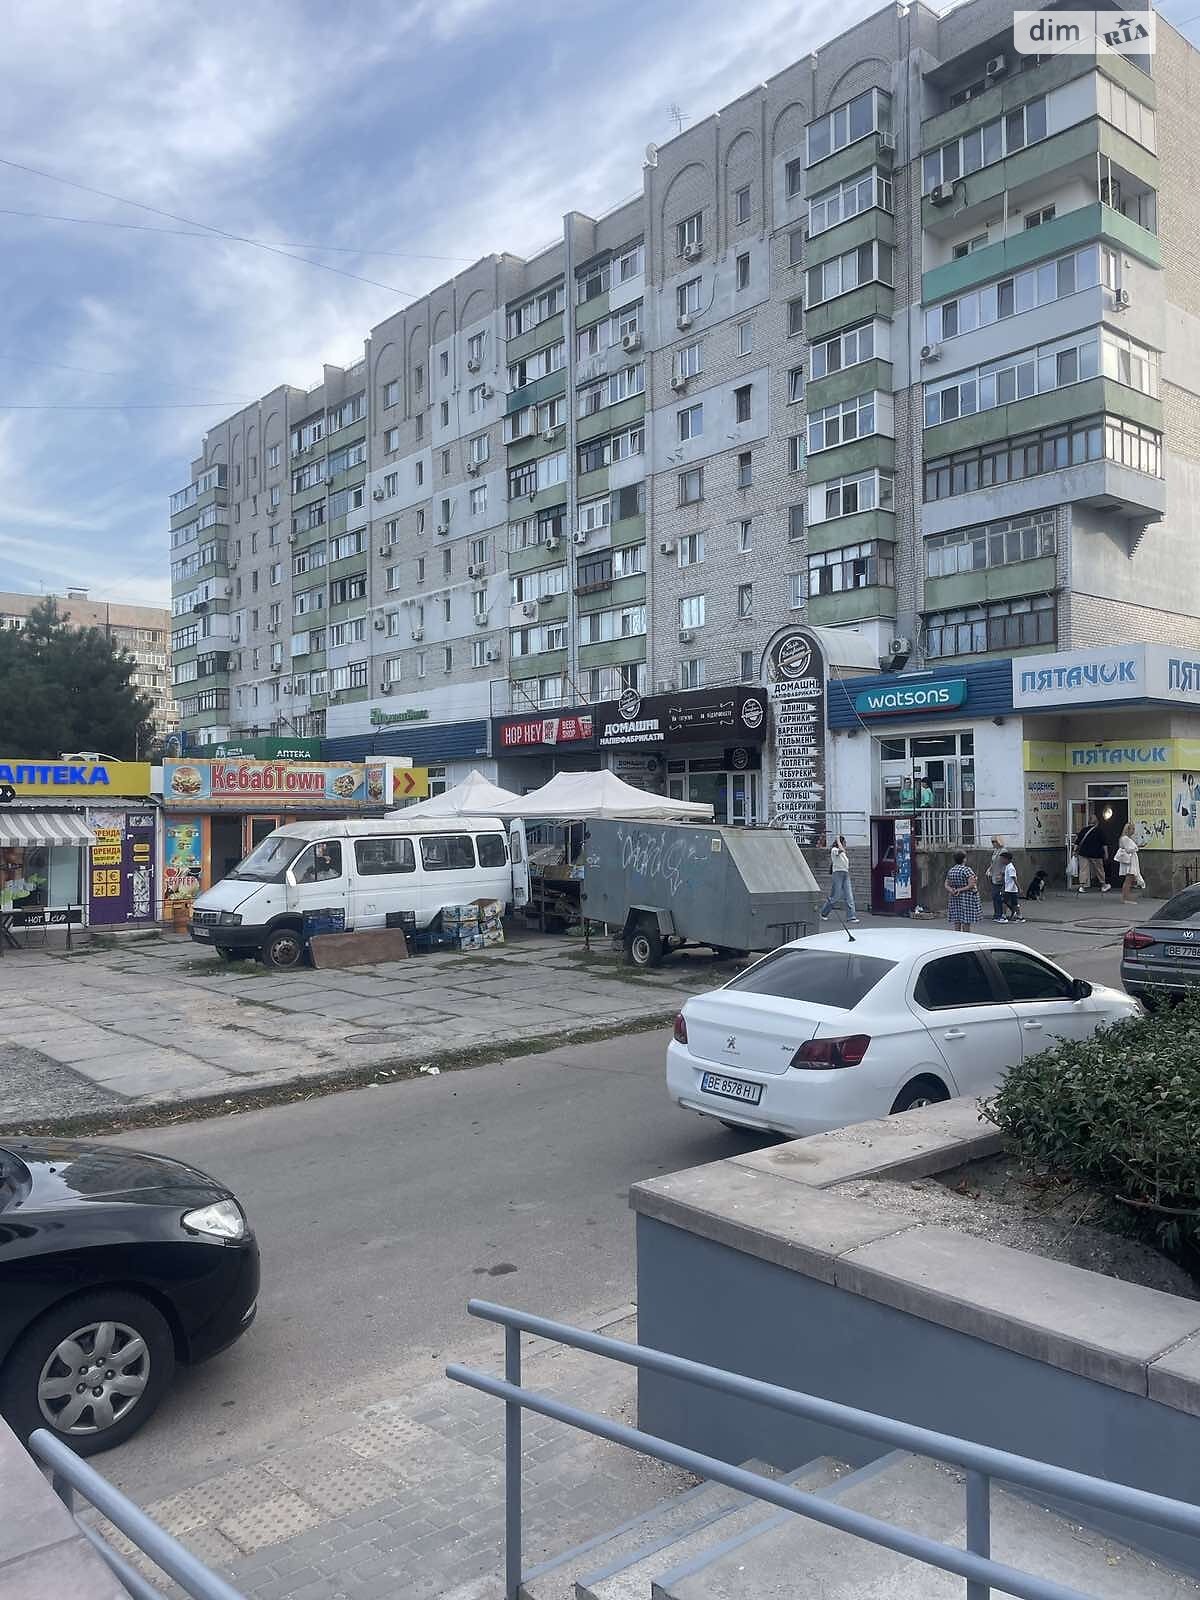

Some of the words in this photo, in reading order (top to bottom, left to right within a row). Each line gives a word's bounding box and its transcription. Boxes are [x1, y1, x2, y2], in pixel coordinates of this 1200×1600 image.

[1021, 660, 1136, 693] ПЯТАЧОК
[774, 681, 818, 694] ДОМАШНІ
[867, 687, 950, 709] watsons
[505, 726, 522, 744] HOP
[524, 723, 542, 742] HEY
[604, 719, 659, 736] ДОМАШНІ
[777, 725, 814, 735] ВАРЕНИКИ
[600, 732, 664, 745] НАПІВФАБРИКАТИ
[778, 736, 812, 746] ПЕЛЬМЕНІ
[276, 750, 311, 759] АПТЕКА
[1071, 747, 1168, 766] ПЯТАЧОК
[781, 758, 810, 767] КОТЛЕТИ
[0, 765, 110, 785] АПТЕКА
[779, 769, 813, 778] ЧЕБУРЕКИ
[779, 780, 813, 789] КОВБАСКИ
[782, 791, 810, 800] ГОЛУБЦІ
[707, 1076, 721, 1090] BE
[721, 1080, 743, 1096] 8578
[743, 1085, 756, 1099] HI
